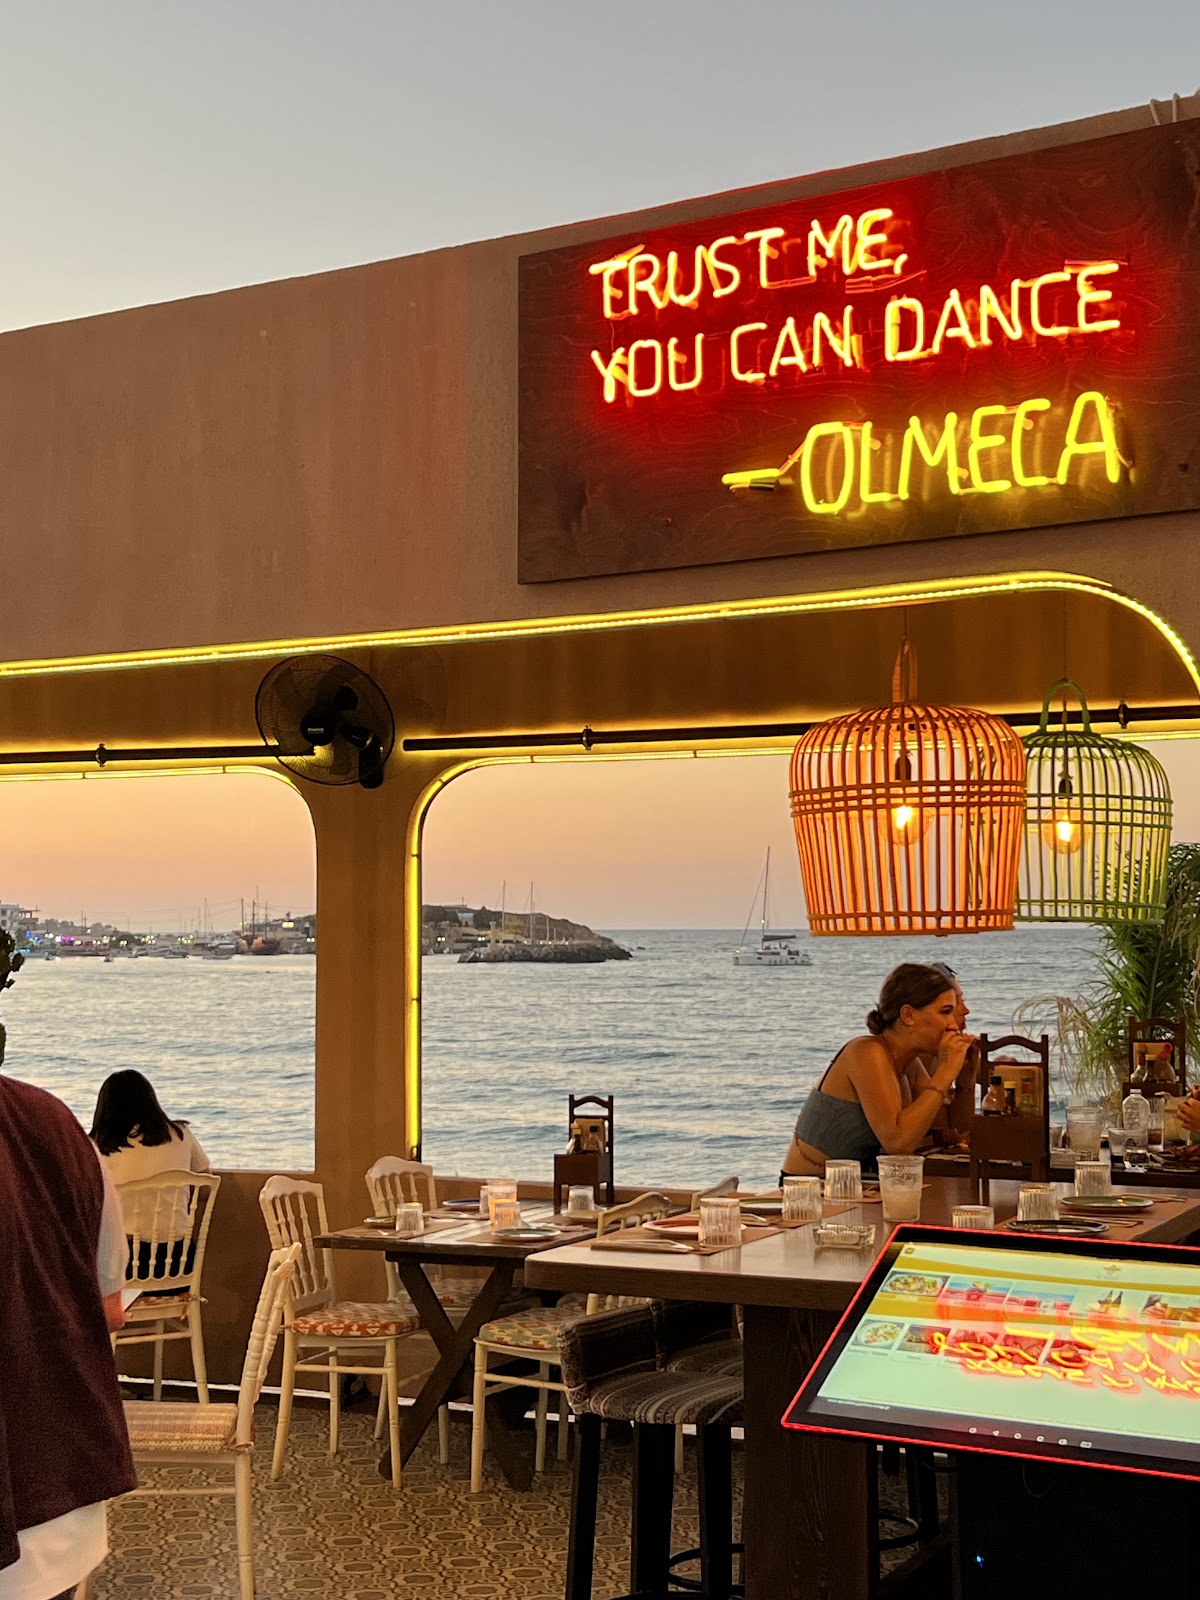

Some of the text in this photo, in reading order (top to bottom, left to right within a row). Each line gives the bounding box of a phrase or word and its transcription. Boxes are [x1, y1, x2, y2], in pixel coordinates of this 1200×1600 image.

[589, 207, 910, 319] TRUST ME,
[591, 262, 1121, 403] YOU CAN DANCE
